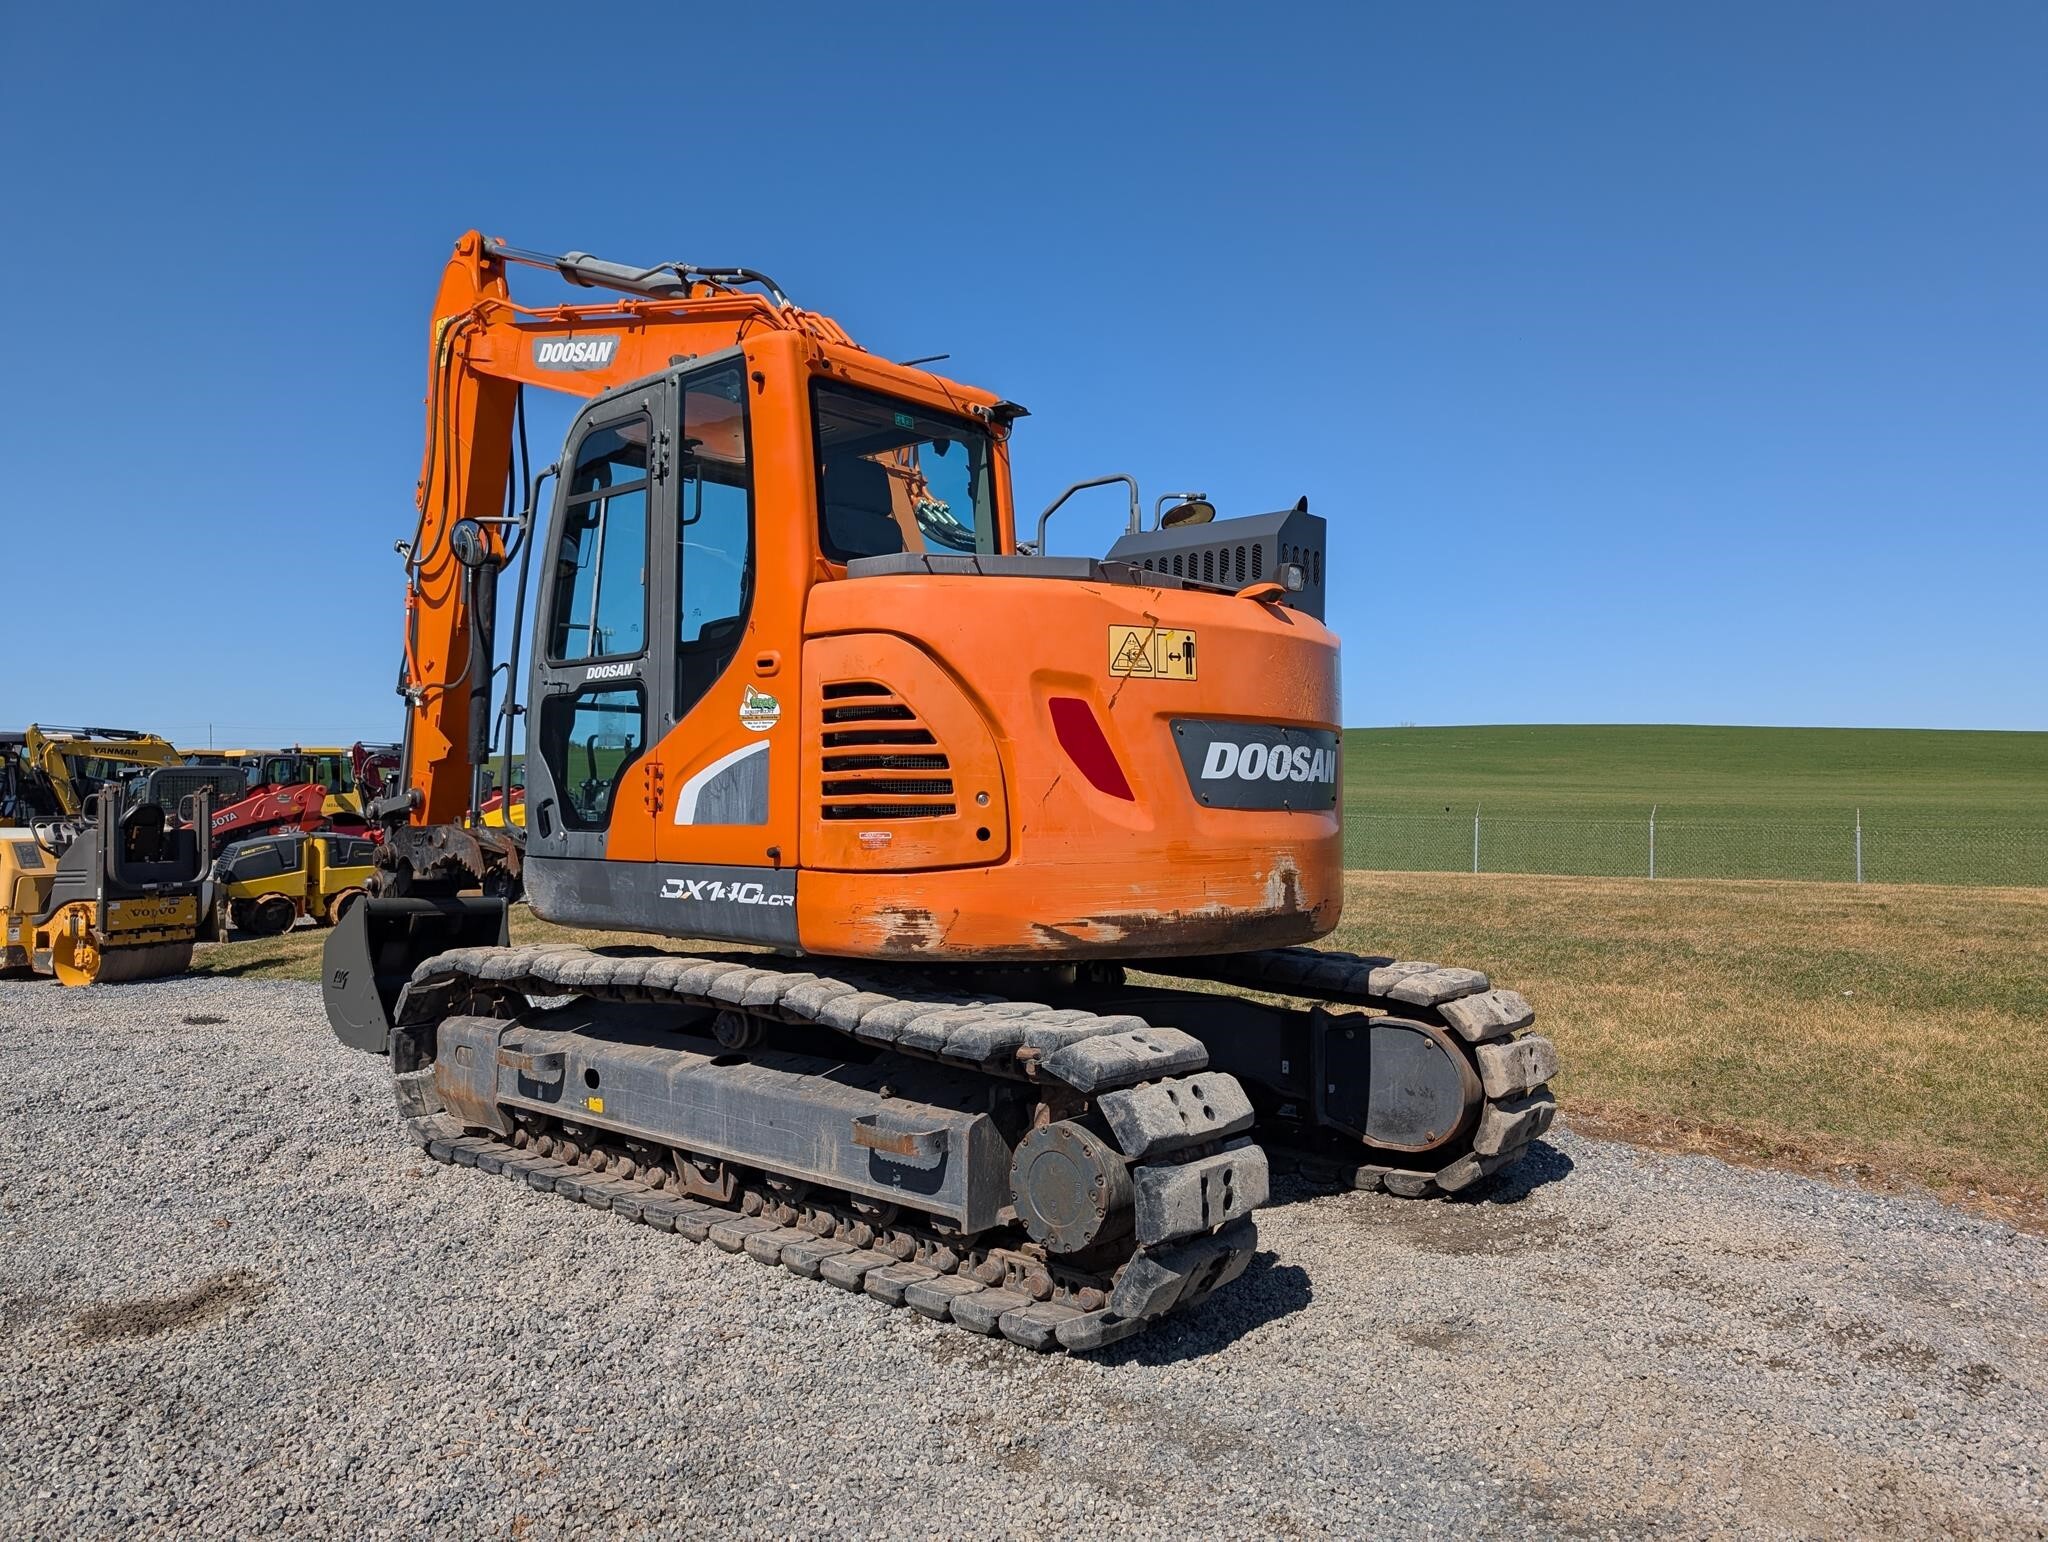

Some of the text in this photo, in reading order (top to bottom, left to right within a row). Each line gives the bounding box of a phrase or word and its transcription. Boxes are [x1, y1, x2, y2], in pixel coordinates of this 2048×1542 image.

[538, 341, 613, 363] DOOSAN
[586, 663, 634, 680] DOOSAN
[93, 746, 139, 756] YANMAR
[1200, 741, 1336, 784] DOOSAN
